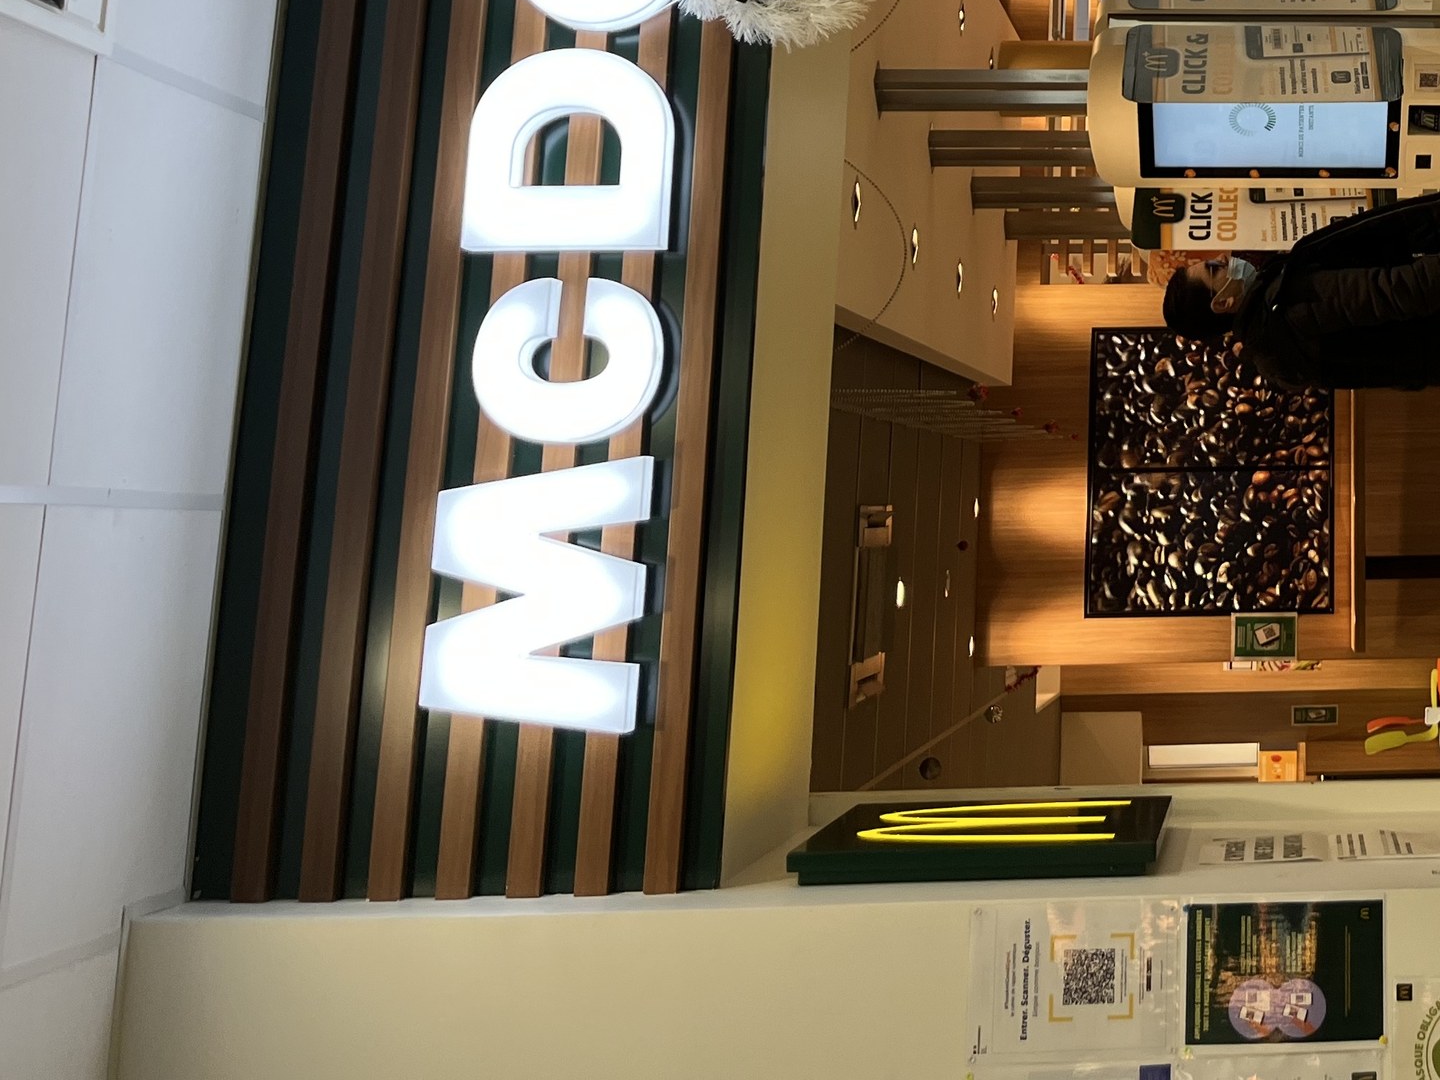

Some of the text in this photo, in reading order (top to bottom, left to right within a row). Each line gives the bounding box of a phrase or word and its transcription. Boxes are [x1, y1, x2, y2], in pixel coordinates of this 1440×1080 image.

[1181, 33, 1208, 94] CLICK &
[1188, 192, 1212, 241] CLICK
[1217, 188, 1238, 242] COLLEC
[1020, 918, 1032, 1040] Entrer. Scanner. Déguster.
